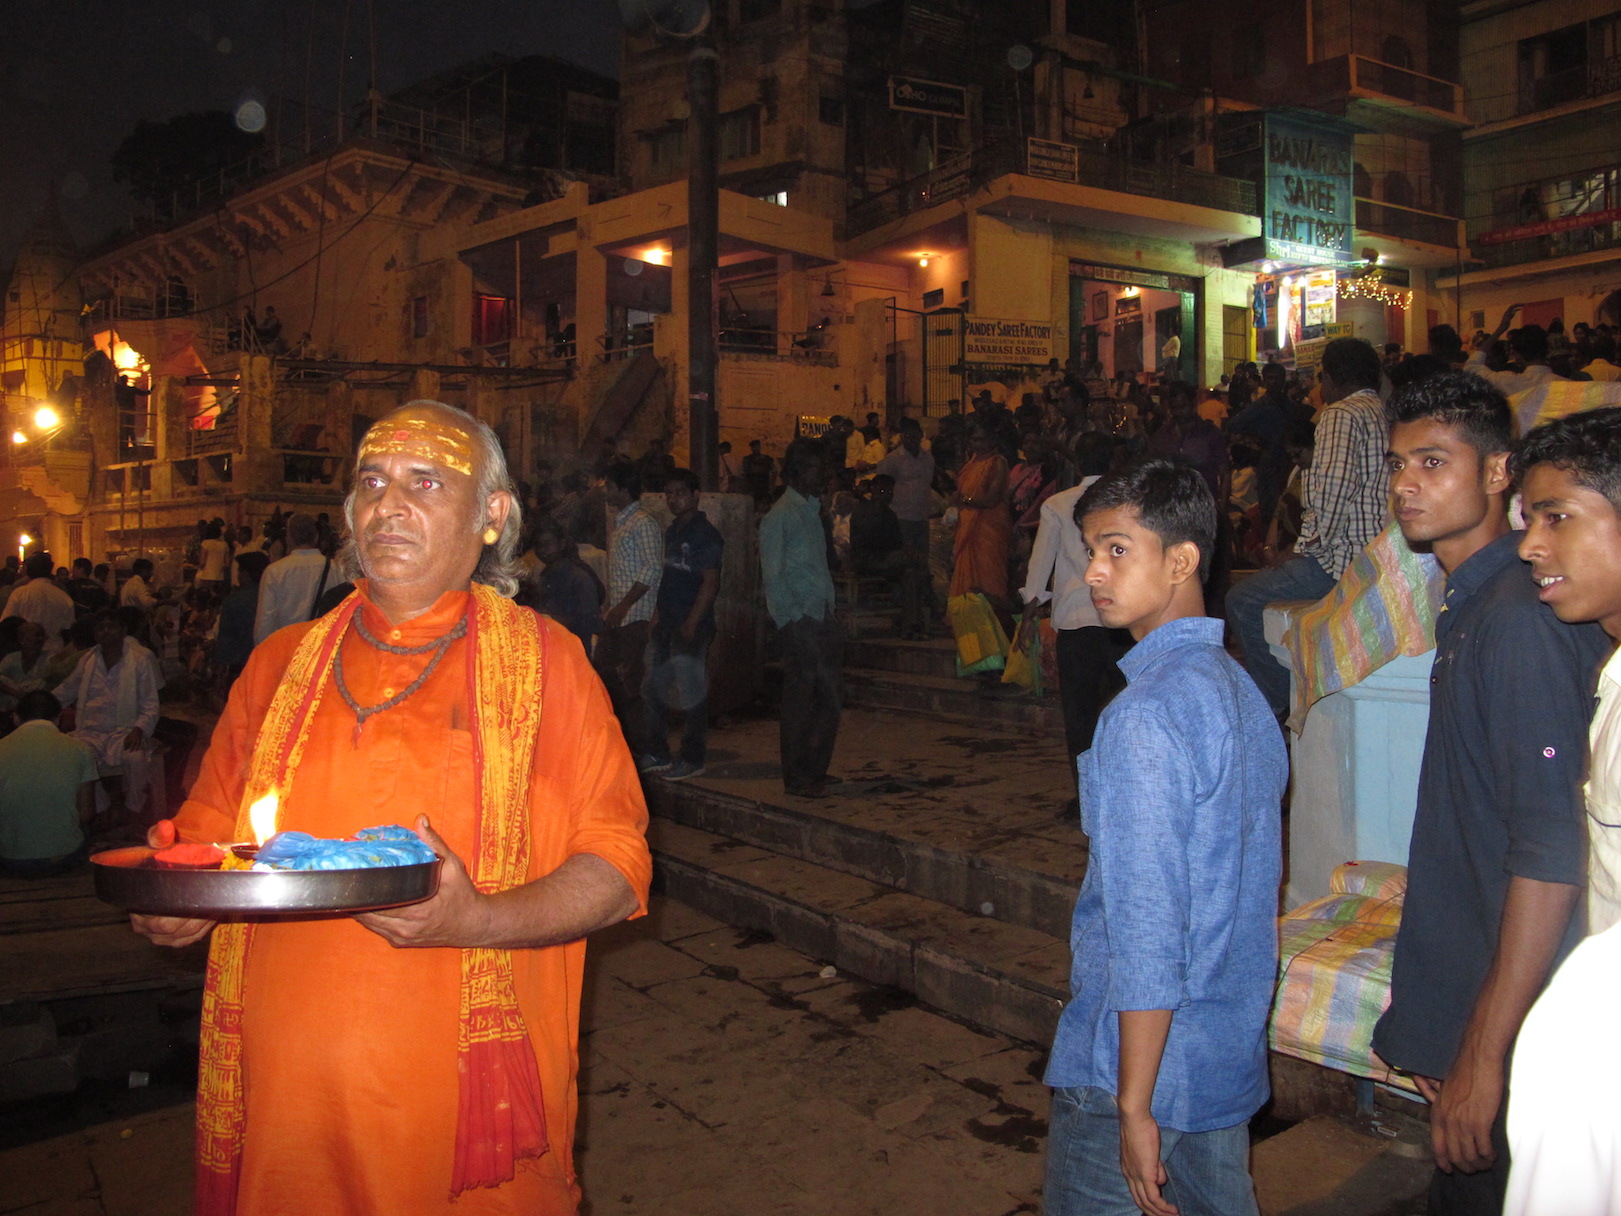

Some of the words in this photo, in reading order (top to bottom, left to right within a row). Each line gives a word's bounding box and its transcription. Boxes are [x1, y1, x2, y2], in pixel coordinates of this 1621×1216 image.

[1283, 174, 1336, 214] SAREE
[1272, 210, 1346, 250] FACTORY
[966, 320, 995, 336] PANDEY
[997, 321, 1020, 337] SAREE
[1020, 322, 1051, 339] FACTORY
[1328, 326, 1341, 335] WAY
[1343, 324, 1350, 333] TO
[967, 344, 1013, 354] BANARASI
[1015, 346, 1048, 356] SAREES
